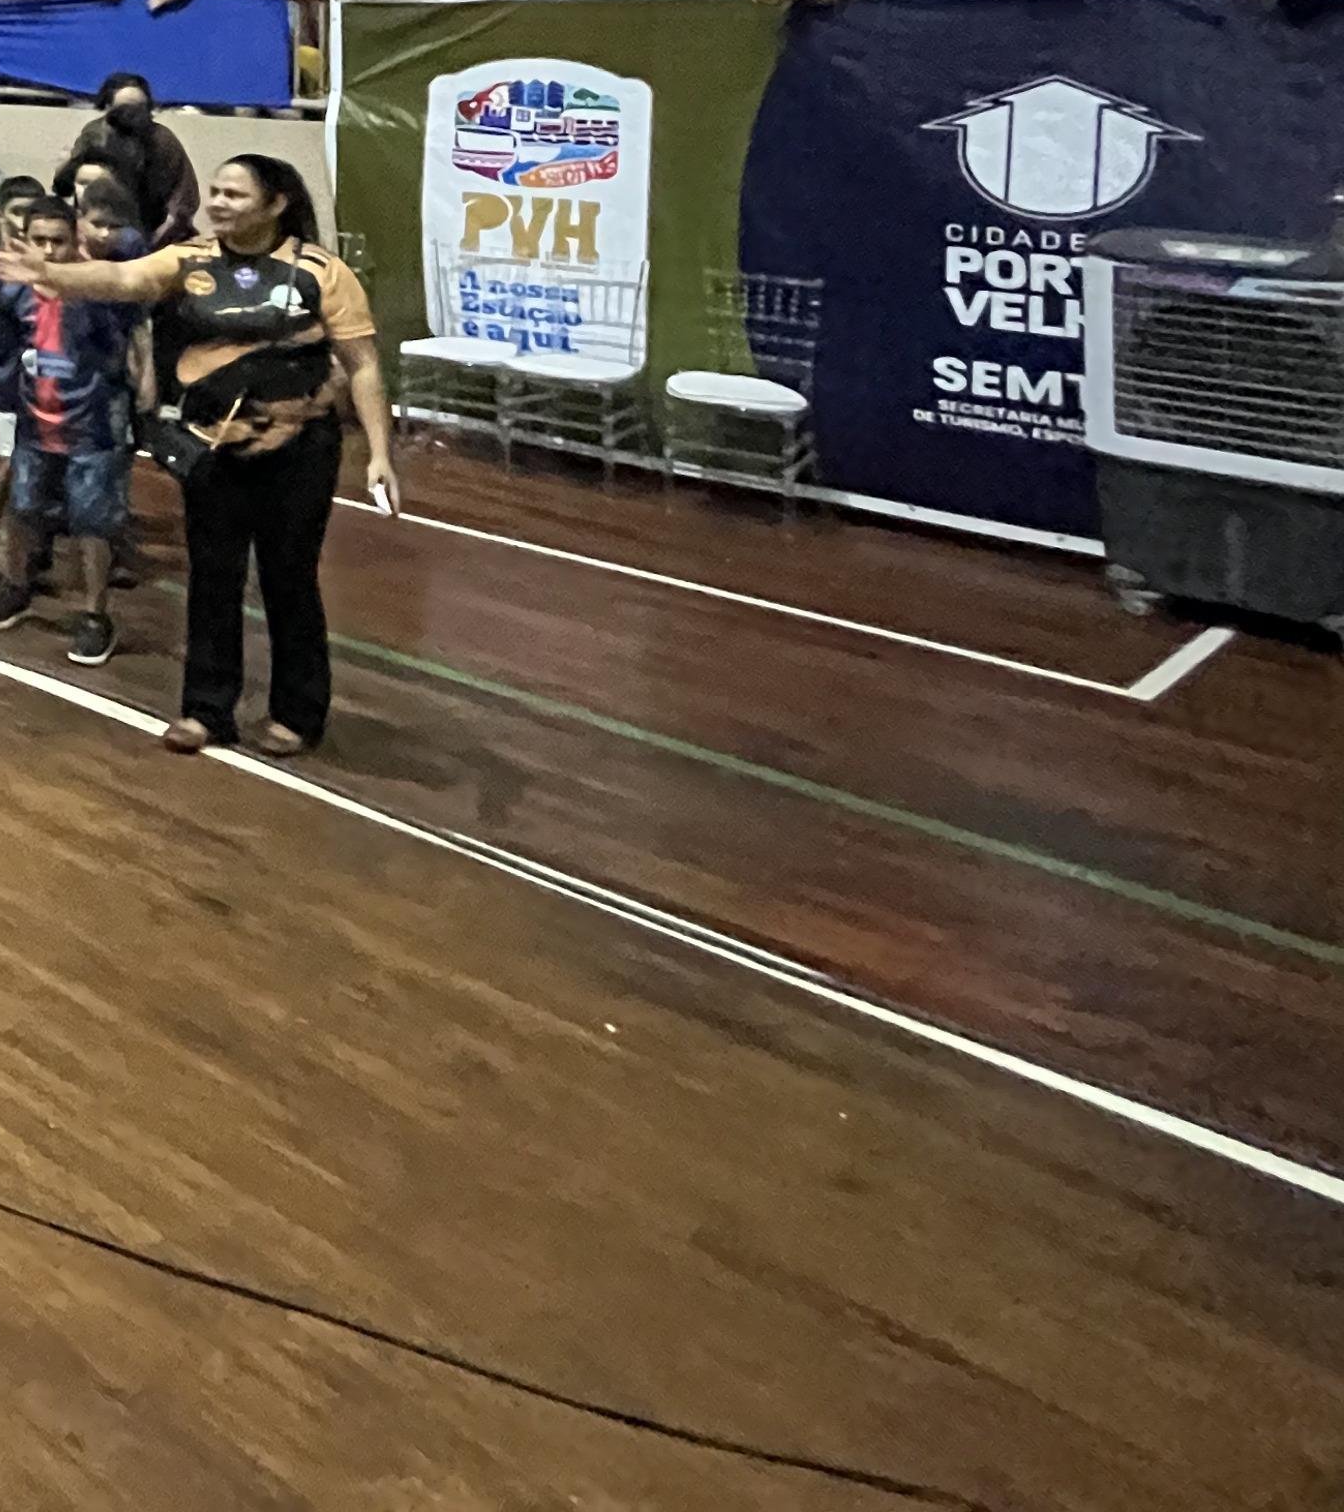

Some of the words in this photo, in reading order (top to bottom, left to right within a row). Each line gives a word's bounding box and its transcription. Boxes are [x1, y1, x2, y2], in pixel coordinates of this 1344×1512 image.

[460, 191, 601, 265] PVH
[944, 223, 1089, 252] CIDADE
[912, 408, 936, 423] DE
[937, 399, 1052, 426] SECRETARIA
